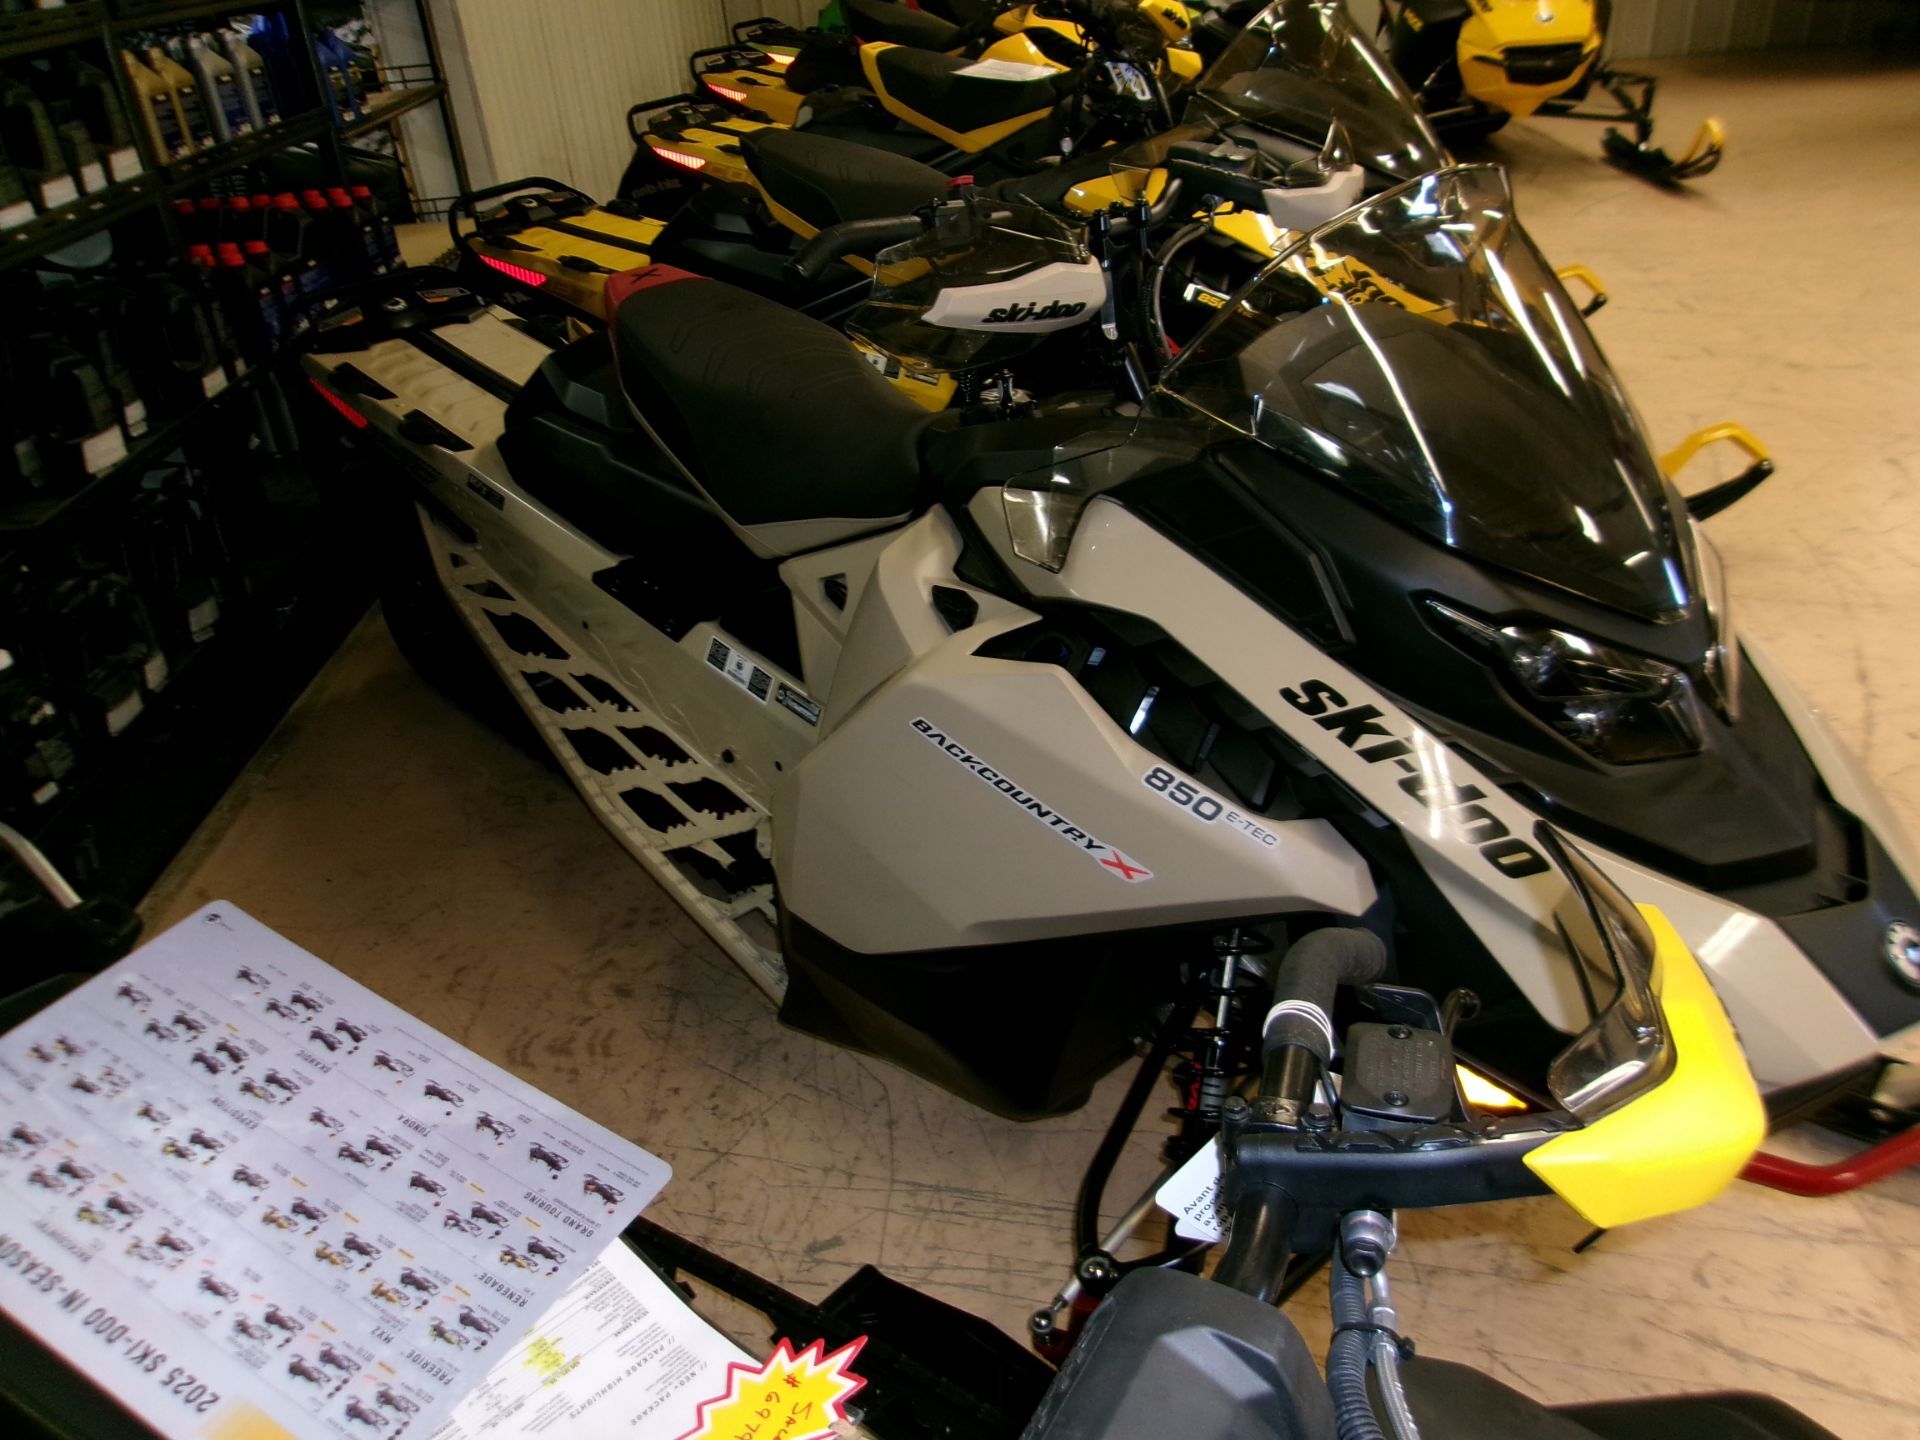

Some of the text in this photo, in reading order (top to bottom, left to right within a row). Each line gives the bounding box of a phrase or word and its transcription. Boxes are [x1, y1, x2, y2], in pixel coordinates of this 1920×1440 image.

[981, 299, 1087, 323] ski-doo
[1278, 679, 1552, 880] ski-doo
[911, 719, 1151, 881] BACKCOUNTRY X
[1143, 766, 1278, 846] 850 E-TEC
[397, 1113, 432, 1138] TUNDRA
[523, 1190, 562, 1220] TOURING
[1183, 1185, 1214, 1216] Avant
[563, 1214, 595, 1239] GRAND
[477, 1271, 529, 1308] RENEGADE
[82, 1307, 168, 1374] SKI-DOO
[370, 1323, 395, 1345] MXZ
[405, 1348, 455, 1386] FREERIDE
[624, 1343, 665, 1377] PACKAGE
[159, 1367, 221, 1414] 2025
[630, 1390, 672, 1426] PACKAGE
